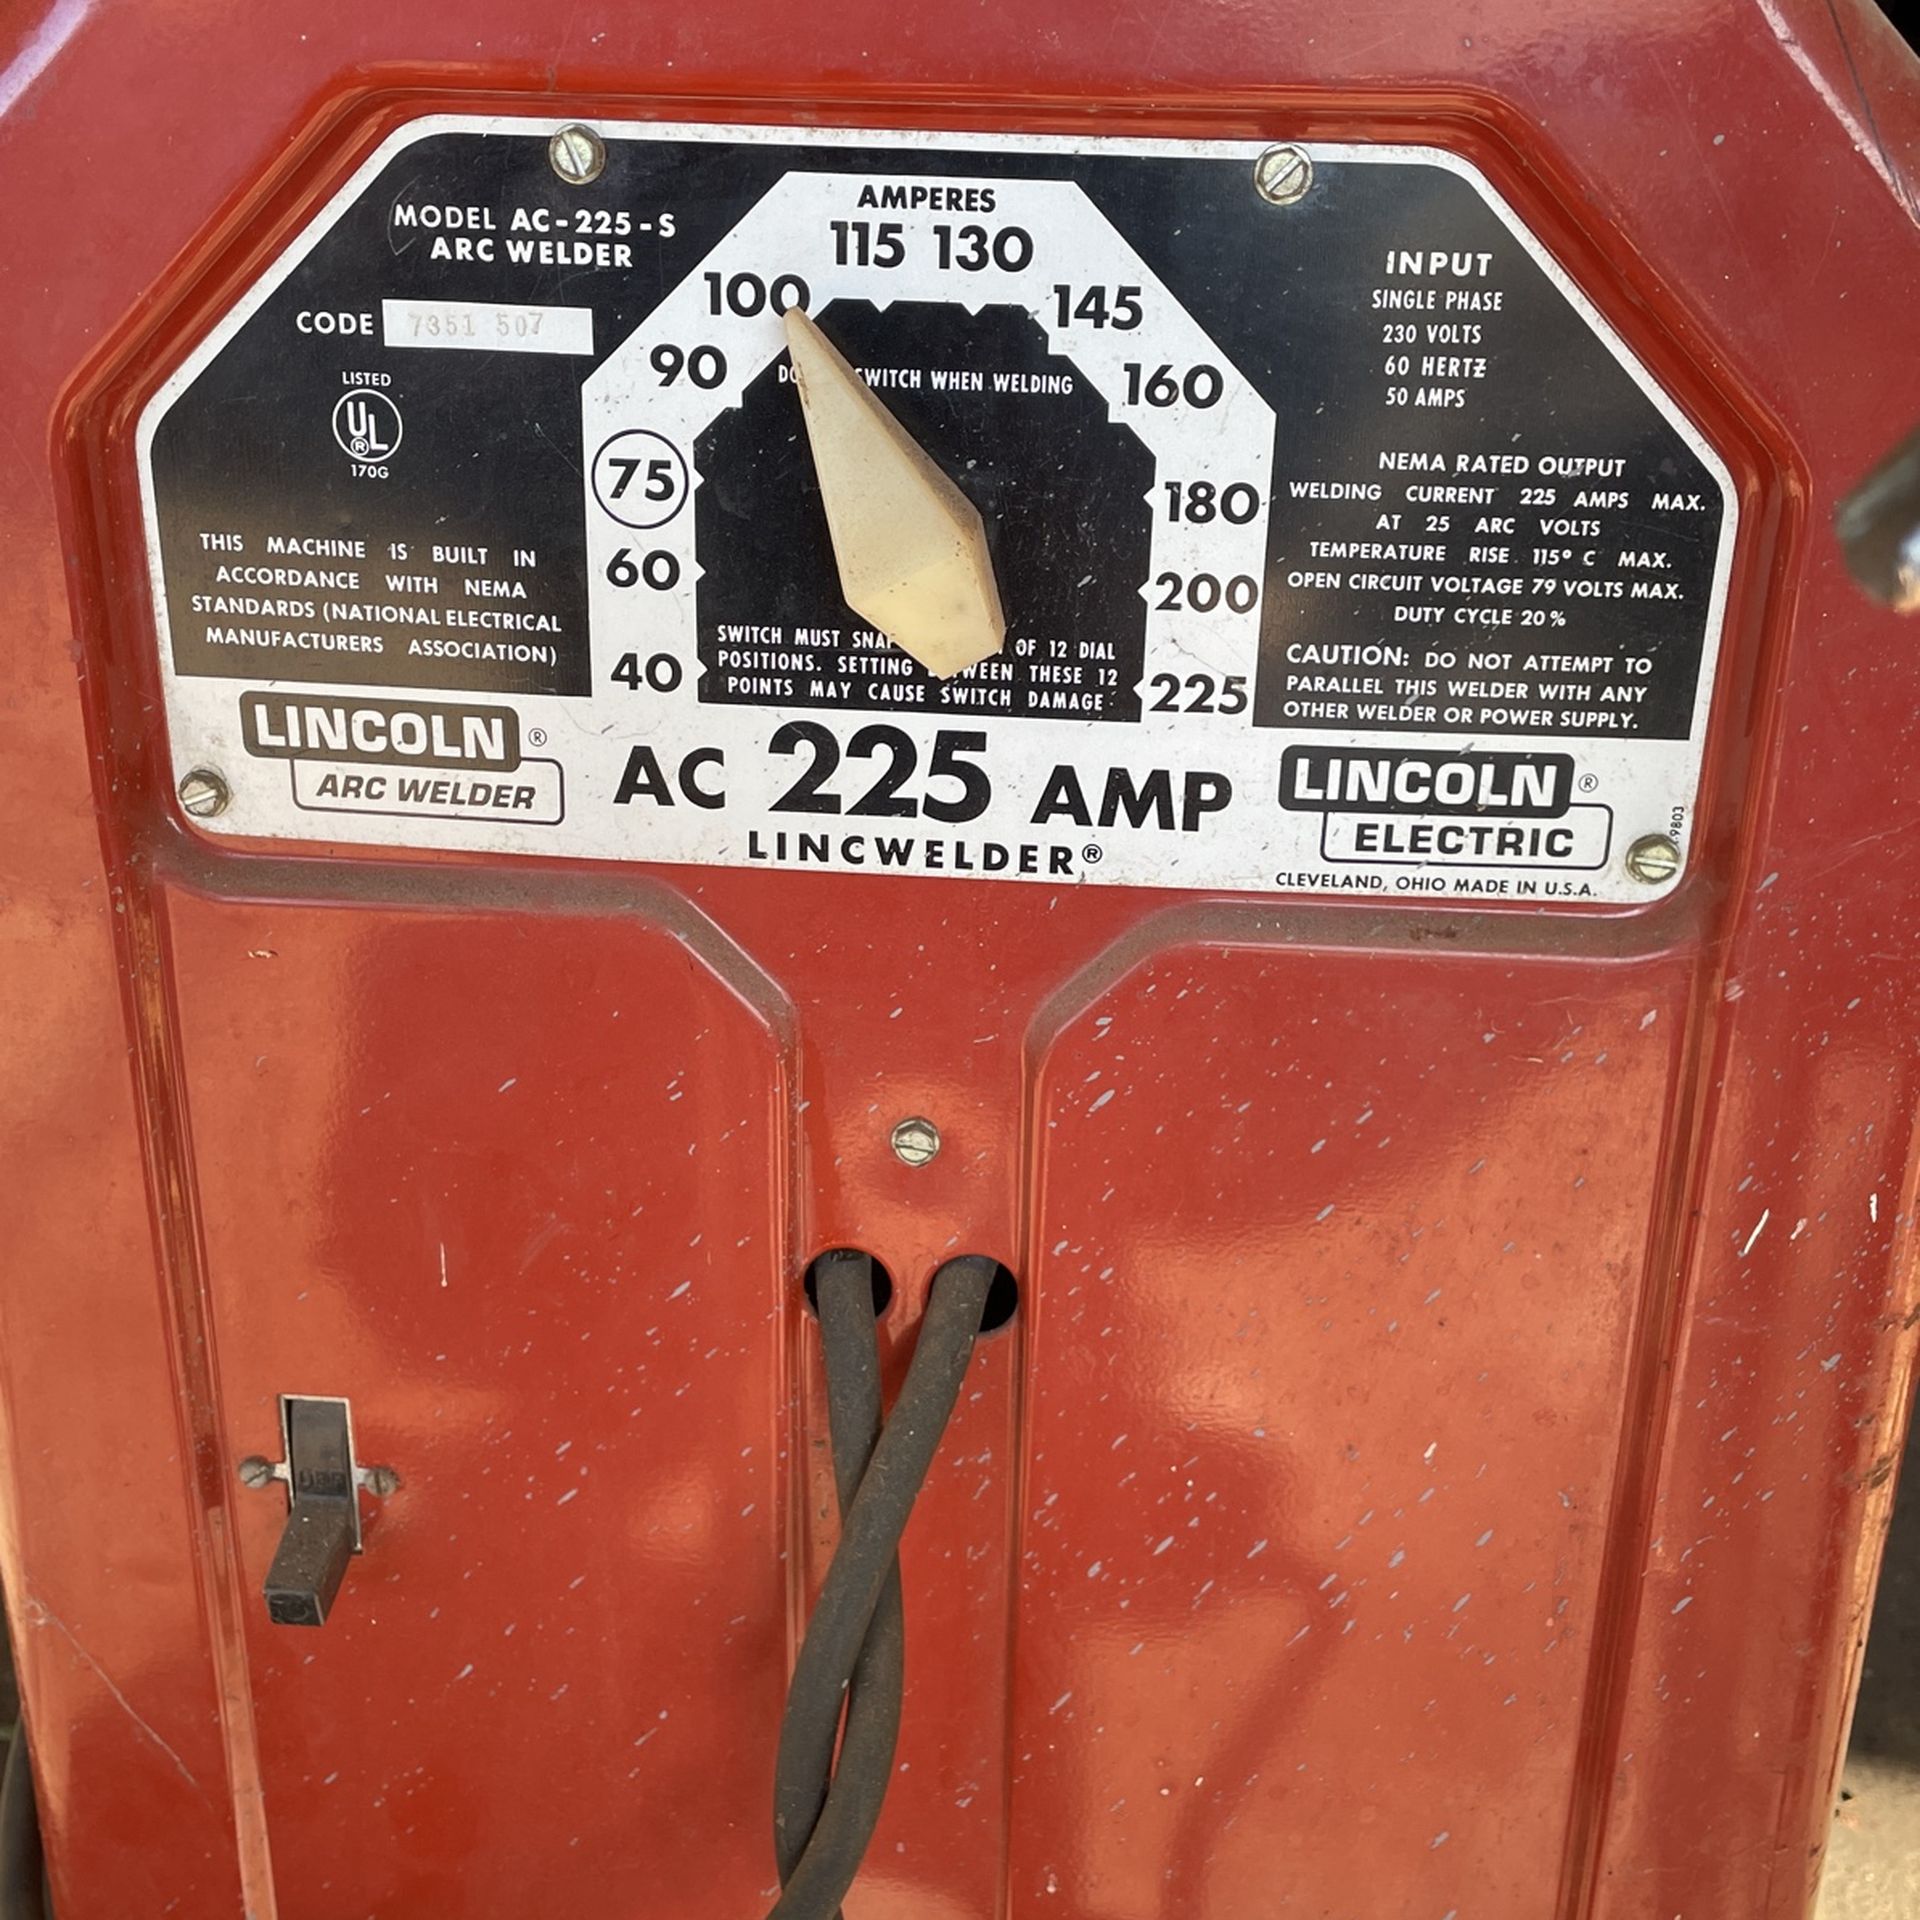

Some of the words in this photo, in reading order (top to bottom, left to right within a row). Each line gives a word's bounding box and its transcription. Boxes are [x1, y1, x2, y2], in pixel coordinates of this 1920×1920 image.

[858, 185, 995, 213] AMPERES
[395, 204, 496, 229] MODEL
[431, 237, 493, 261] ARC
[506, 240, 632, 267] WELDER
[831, 221, 905, 268] 115
[934, 225, 1033, 272] 130
[1387, 251, 1492, 276] INPUT
[704, 272, 810, 318] 100
[1054, 285, 1142, 330] 145
[1372, 290, 1436, 309] SINGLE
[1446, 291, 1502, 310] PHASE
[297, 312, 373, 334] CODE
[409, 313, 475, 338] 7351
[496, 313, 544, 338] 507
[1383, 325, 1416, 343] 230
[1427, 325, 1481, 343] VOLTS
[343, 372, 391, 386] LISTED
[650, 344, 727, 389] 90
[931, 371, 982, 391] WHEN
[994, 374, 1072, 394] WELDING
[1385, 356, 1409, 375] 60
[1422, 357, 1486, 377] HERTZ
[1124, 363, 1223, 409] 160
[1386, 387, 1408, 405] 50
[1415, 388, 1465, 407] AMPS
[347, 401, 388, 450] UL
[351, 464, 388, 478] 170G
[609, 458, 674, 501] 75
[1379, 452, 1445, 471] NEMA
[1457, 455, 1529, 473] RATED
[1539, 457, 1626, 477] OUTPUT
[1165, 481, 1259, 524] 180
[1290, 482, 1381, 500] WELDING
[1406, 486, 1494, 504] CURRENT
[1520, 488, 1555, 505] 225
[1574, 492, 1628, 508] AMPS
[1652, 494, 1705, 510] MAX.
[1376, 514, 1401, 530] AT
[1426, 516, 1449, 532] 25
[1475, 518, 1515, 534] ARC
[1540, 519, 1600, 536] VOLTS
[200, 534, 243, 551] THIS
[267, 537, 365, 558] MACHINE
[388, 543, 407, 560] IS
[433, 546, 487, 564] BUILT
[514, 550, 535, 567] IN
[1310, 542, 1446, 561] TEMPERATURE
[1470, 547, 1509, 563] RISE
[1583, 551, 1595, 566] C
[1618, 552, 1671, 568] MAX.
[217, 566, 359, 589] ACCORDANCE
[386, 575, 437, 593] WITH
[465, 579, 526, 598] NEMA
[607, 548, 680, 590] 60
[1155, 572, 1258, 614] 200
[1288, 572, 1340, 588] OPEN
[1349, 574, 1423, 591] CIRCUIT
[1431, 577, 1523, 594] VOLTAGE
[1532, 579, 1556, 594] 79
[1564, 581, 1623, 597] VOLTS
[1631, 583, 1683, 599] MAX.
[192, 595, 315, 617] STANDARDS
[324, 602, 440, 625] (NATIONAL
[446, 610, 561, 631] ELECTRICAL
[1395, 606, 1445, 622] DUTY
[1454, 608, 1512, 625] CYCLE
[207, 627, 383, 653] MANUFACTURERS
[408, 639, 556, 666] ASSOCIATION)
[718, 625, 781, 644] SWITCH
[795, 628, 840, 647] MUST
[1016, 639, 1042, 656] OF
[1050, 640, 1067, 657] 12
[1080, 642, 1115, 660] DIAL
[611, 653, 682, 692] 40
[719, 650, 821, 671] POSITIONS.
[838, 656, 912, 676] SETTING
[1030, 665, 1082, 683] THESE
[1099, 669, 1117, 685] 12
[1287, 644, 1409, 666] CAUTION:
[1425, 652, 1456, 668] DO
[1468, 654, 1512, 669] NOT
[1523, 655, 1613, 672] ATTEMPT
[1626, 658, 1652, 674] TO
[728, 677, 793, 695] POINTS
[810, 680, 851, 698] MAY
[868, 683, 924, 702] CAUSE
[940, 684, 1010, 706] SWITCH
[1150, 673, 1247, 714] 225
[1287, 676, 1383, 694] PARALLEL
[1396, 679, 1436, 695] THIS
[1448, 681, 1528, 698] WELDER
[1539, 684, 1591, 700] WITH
[1600, 687, 1647, 702] ANY
[1284, 701, 1348, 718] OTHER
[1357, 704, 1436, 722] WELDER
[1444, 707, 1473, 723] OR
[1480, 709, 1553, 725] POWER
[1560, 711, 1637, 728] SUPPLY.
[255, 705, 504, 759] LINCOLN
[316, 774, 386, 799] ARC
[399, 779, 535, 809] WELDER
[614, 746, 725, 809] AC
[768, 720, 990, 824] 225
[1030, 765, 1232, 832] AMP
[1295, 758, 1556, 806] LINCOLN
[1355, 823, 1573, 857] ELECTRIC
[1276, 873, 1387, 892] CLEVELAND,
[1396, 877, 1446, 891] OHIO
[1454, 879, 1508, 893] MADE
[1517, 881, 1536, 894] IN
[1545, 882, 1597, 896] U.S.A.
